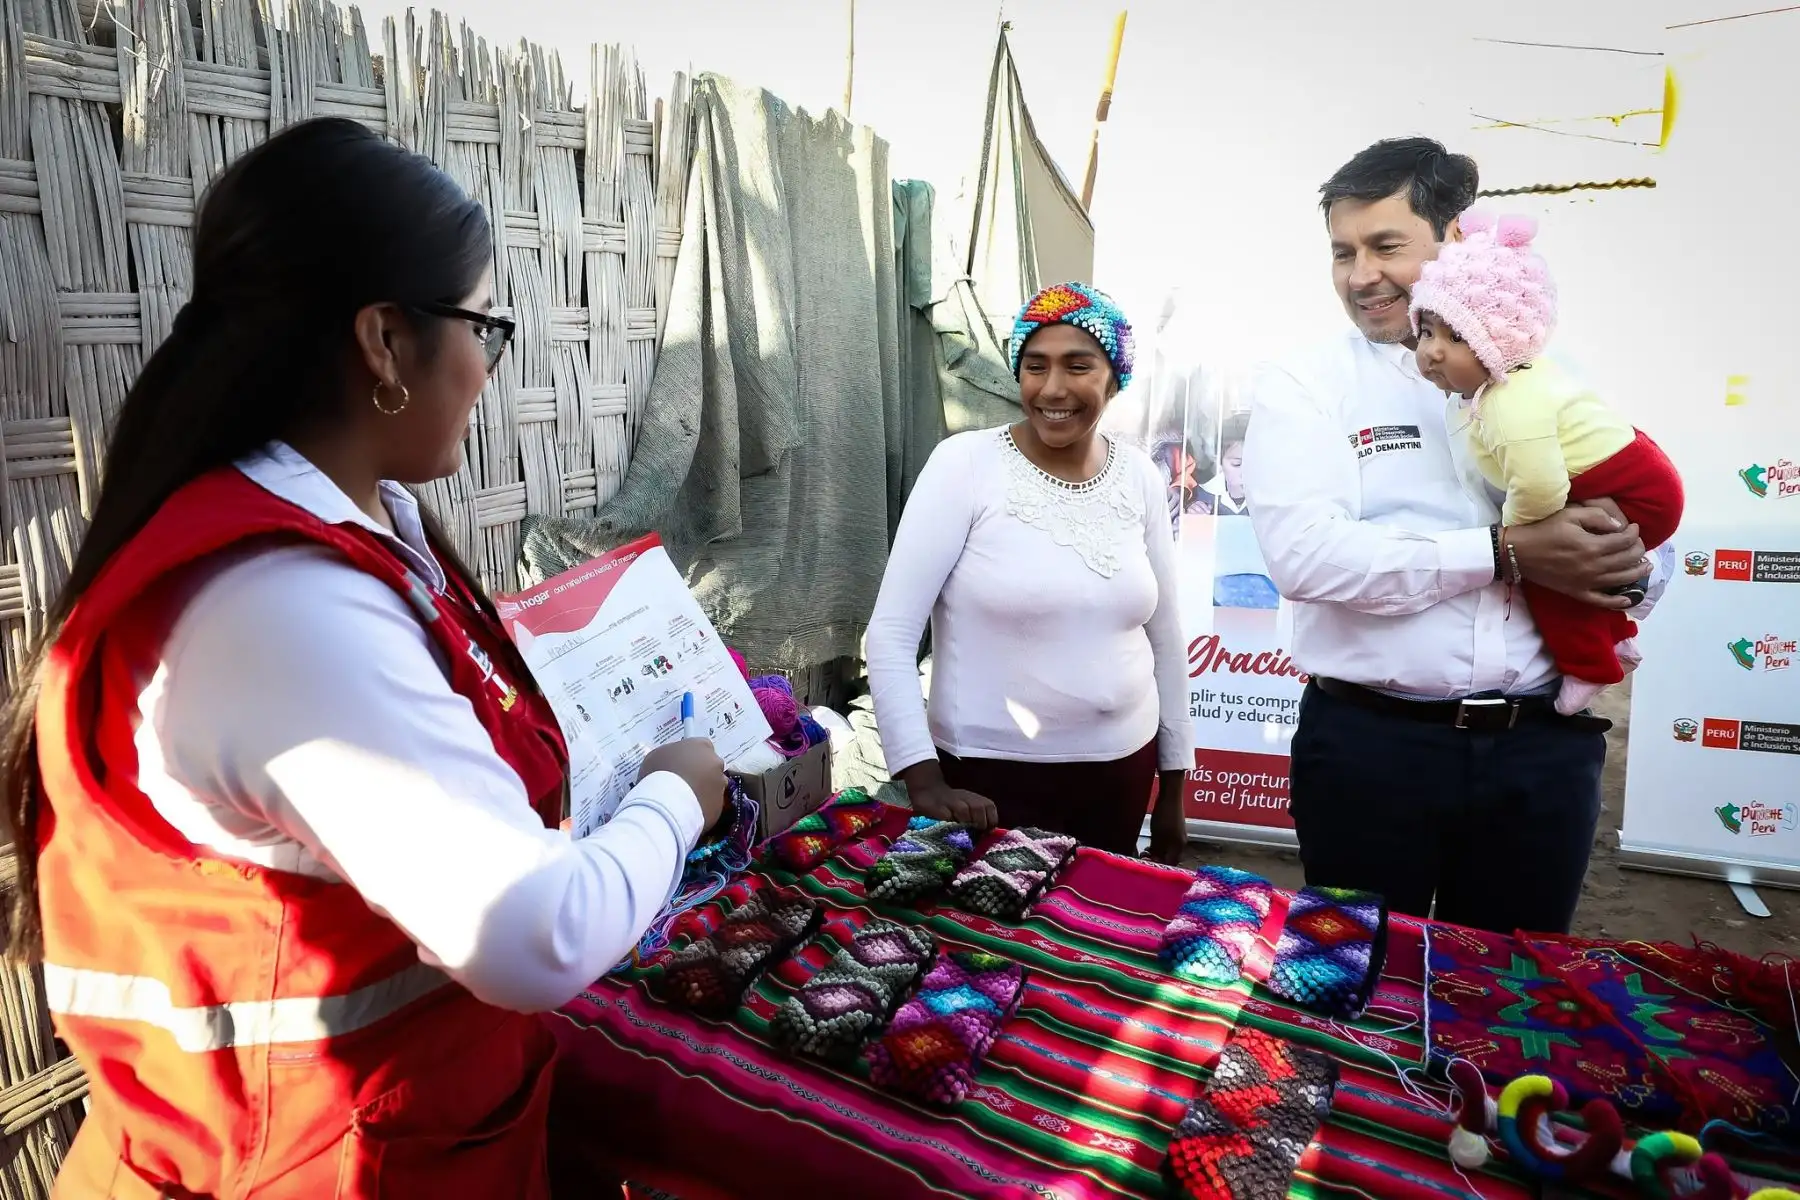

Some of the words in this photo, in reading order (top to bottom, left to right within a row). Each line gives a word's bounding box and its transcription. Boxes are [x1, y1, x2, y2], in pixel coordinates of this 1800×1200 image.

[1376, 442, 1422, 452] DEMARTINI
[1717, 559, 1748, 570] PERÚ
[1757, 563, 1769, 571] de
[519, 589, 550, 610] hogar
[1765, 634, 1778, 642] Con
[1765, 655, 1790, 669] Perú
[1189, 689, 1217, 704] plir
[1220, 692, 1243, 704] tus
[1247, 696, 1300, 711] compr
[1225, 710, 1234, 723] y
[1706, 728, 1735, 739] PERÚ
[1744, 725, 1790, 735] Ministerio
[1744, 731, 1756, 740] de
[1751, 741, 1791, 750] Inclusión
[1194, 789, 1216, 803] en
[1220, 788, 1236, 805] el
[1750, 800, 1765, 809] Con
[1751, 821, 1776, 834] Perú
